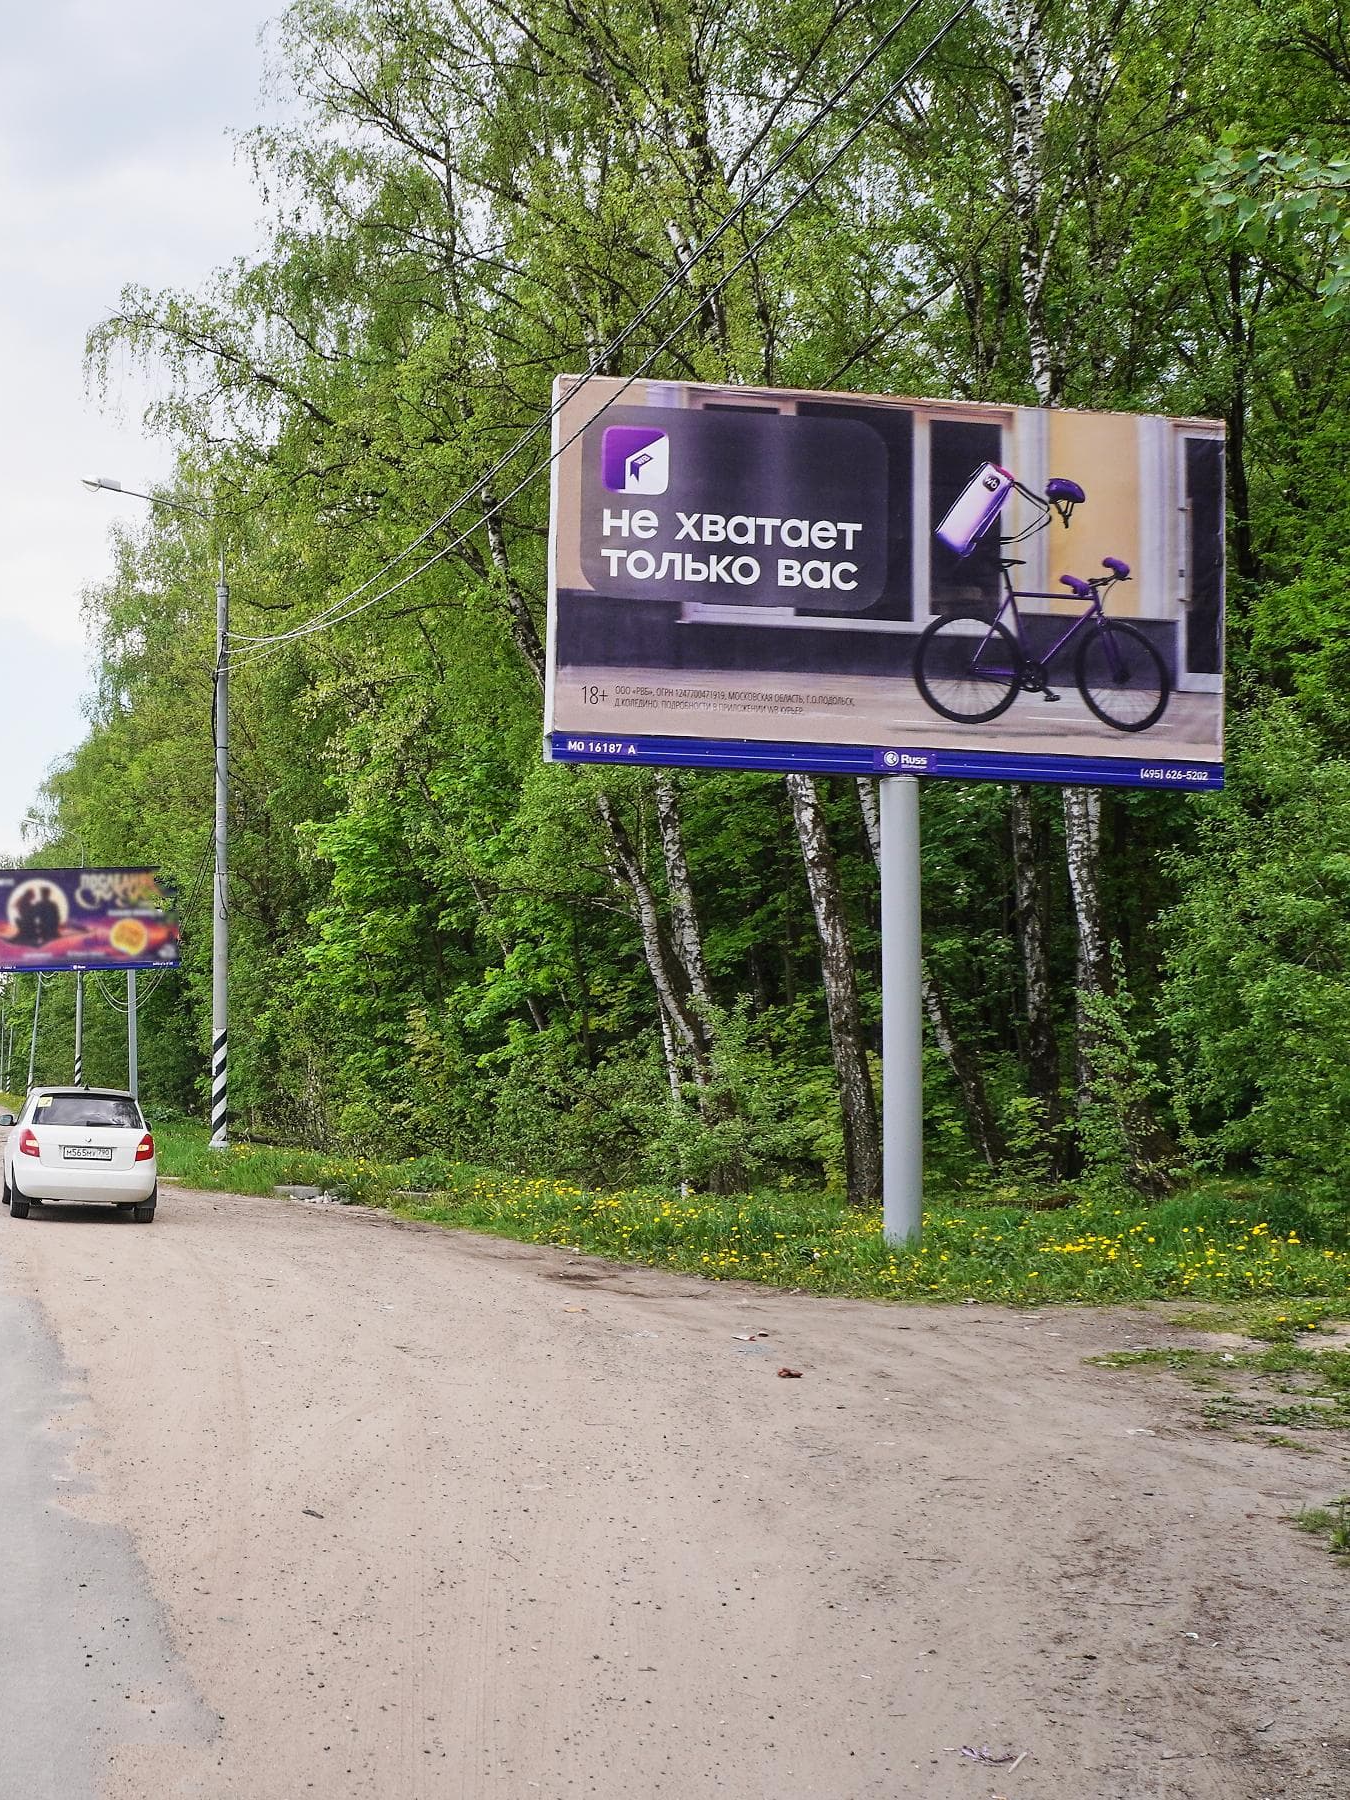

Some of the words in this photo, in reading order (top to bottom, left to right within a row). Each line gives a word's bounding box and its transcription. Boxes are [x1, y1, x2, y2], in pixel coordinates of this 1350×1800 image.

[581, 685, 609, 705] 18+
[656, 687, 674, 697] ОГРН
[728, 691, 773, 702] МОСКОВСКАЯ
[588, 742, 623, 753] 16187
[900, 754, 928, 765] Russ
[1140, 768, 1164, 779] (495)
[1165, 769, 1209, 781] 626-5202
